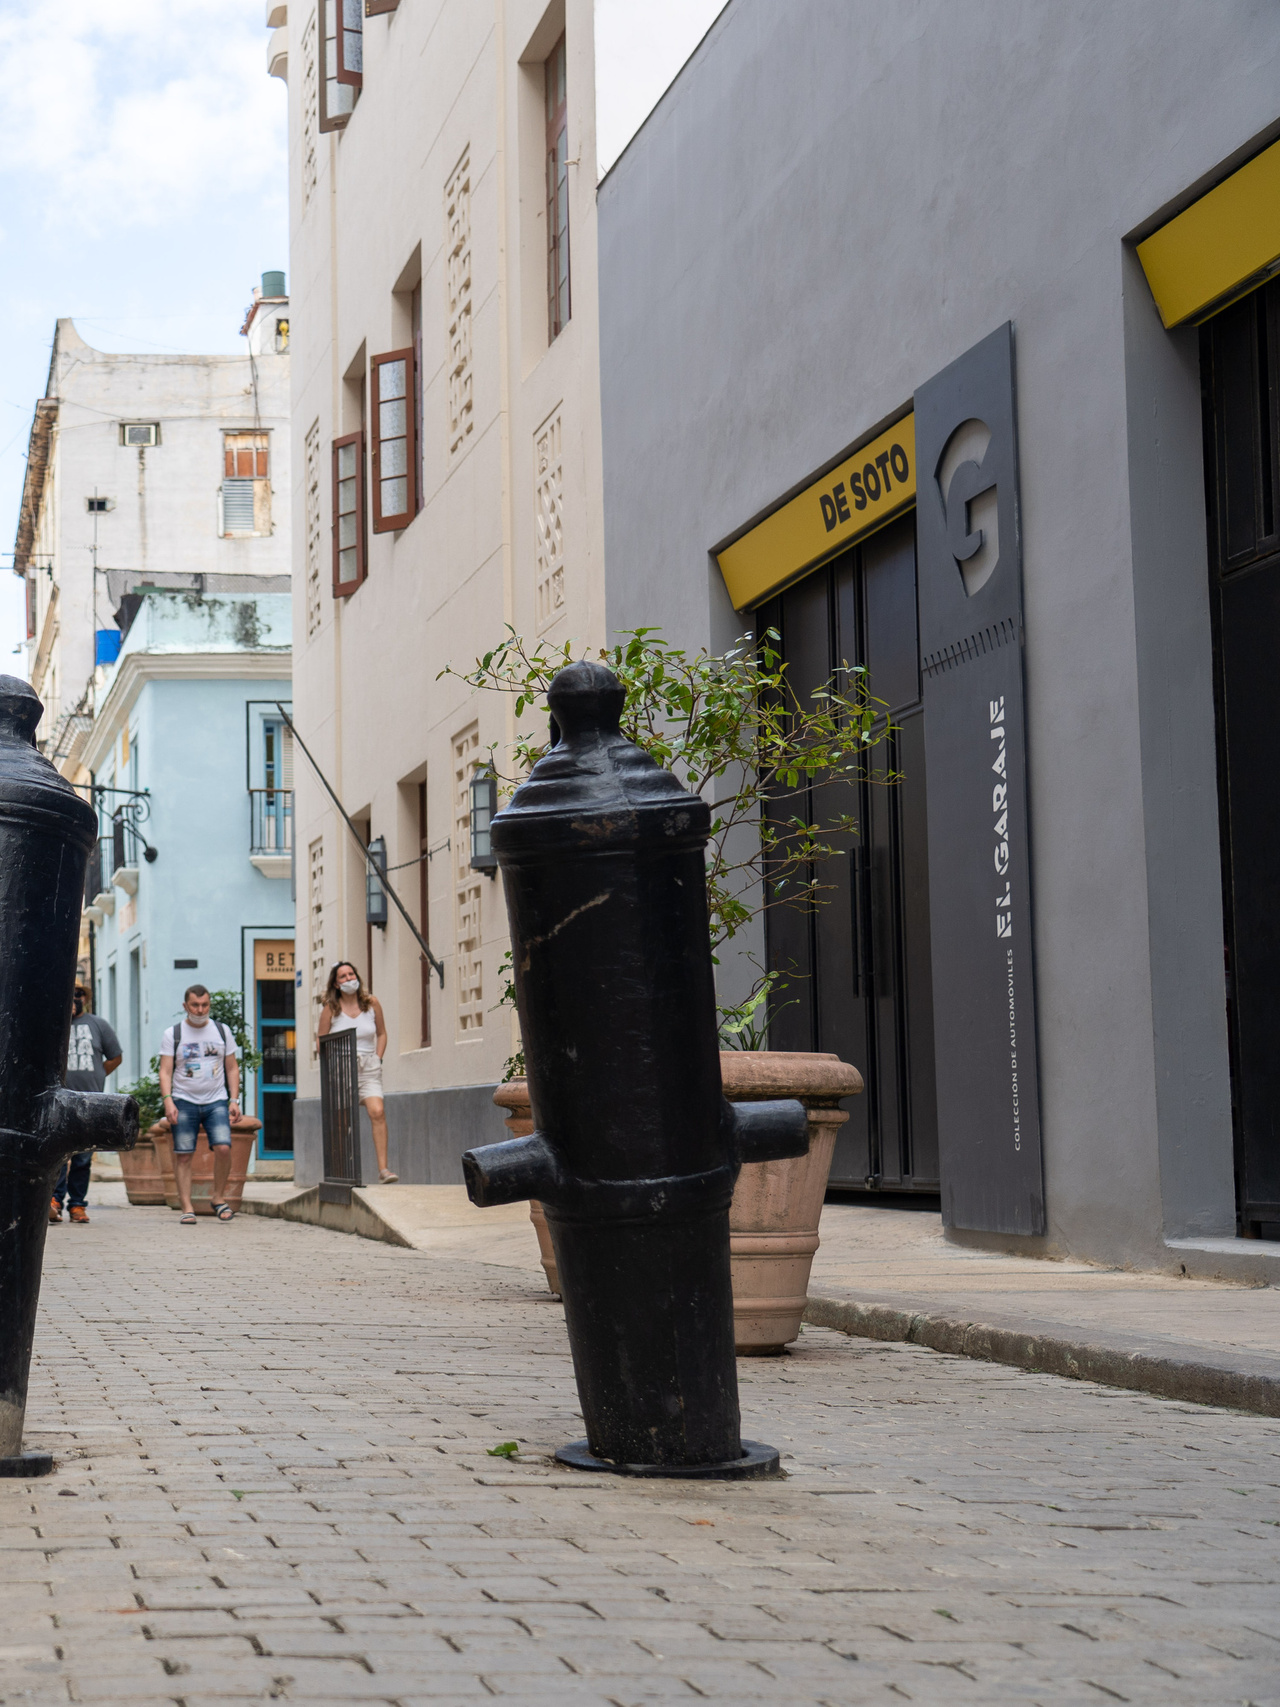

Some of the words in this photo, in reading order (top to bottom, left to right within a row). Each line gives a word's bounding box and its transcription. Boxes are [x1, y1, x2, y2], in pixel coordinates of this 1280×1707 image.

[819, 481, 851, 533] DE
[850, 443, 909, 511] SOTO
[989, 696, 1009, 875] GARAJE
[996, 882, 1012, 938] EL
[1007, 949, 1016, 1047] AUTOMÓVILES
[1011, 1051, 1018, 1069] DE
[1012, 1073, 1021, 1151] COLECCIÓN
